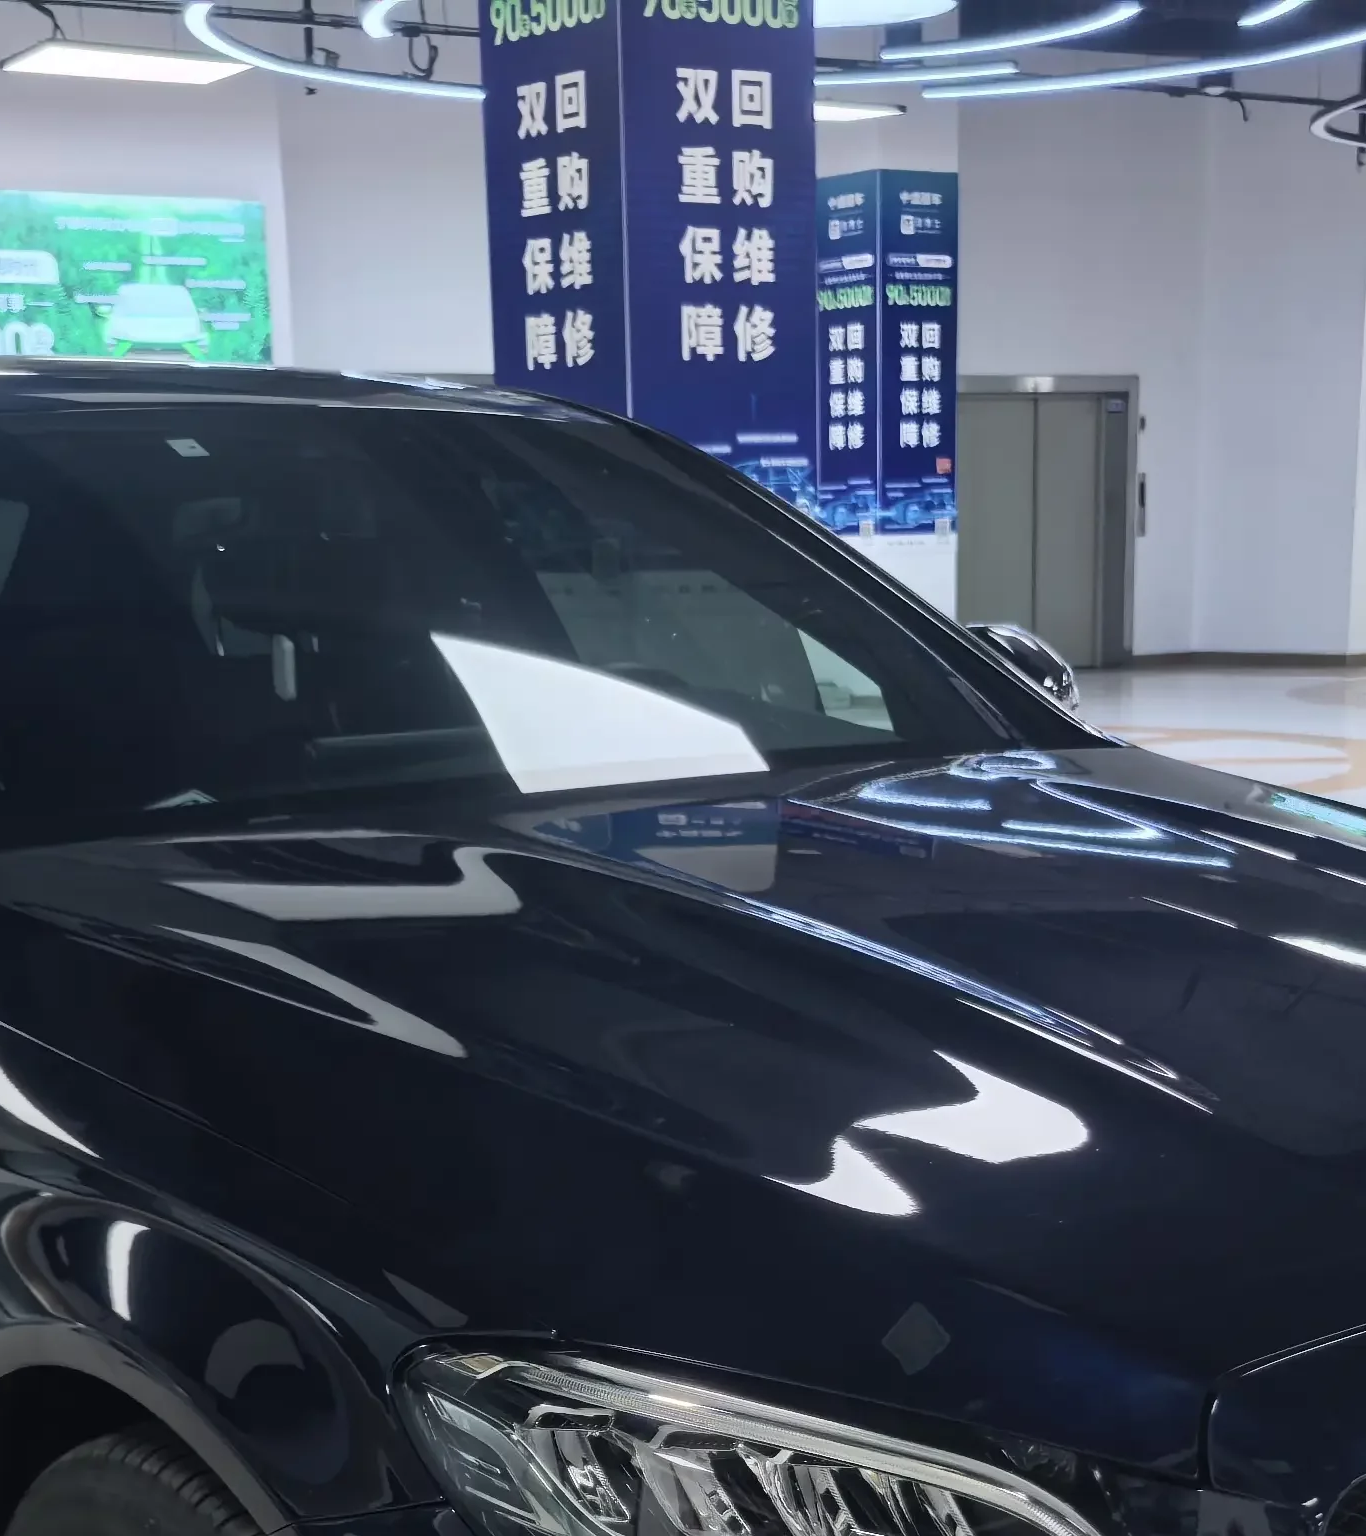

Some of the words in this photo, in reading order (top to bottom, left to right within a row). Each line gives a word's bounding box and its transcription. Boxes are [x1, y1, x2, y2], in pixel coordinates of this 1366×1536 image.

[516, 81, 558, 371] 双重保障
[554, 68, 596, 368] 回购维修
[675, 66, 725, 362] 双重保障
[731, 68, 776, 363] 回购维修
